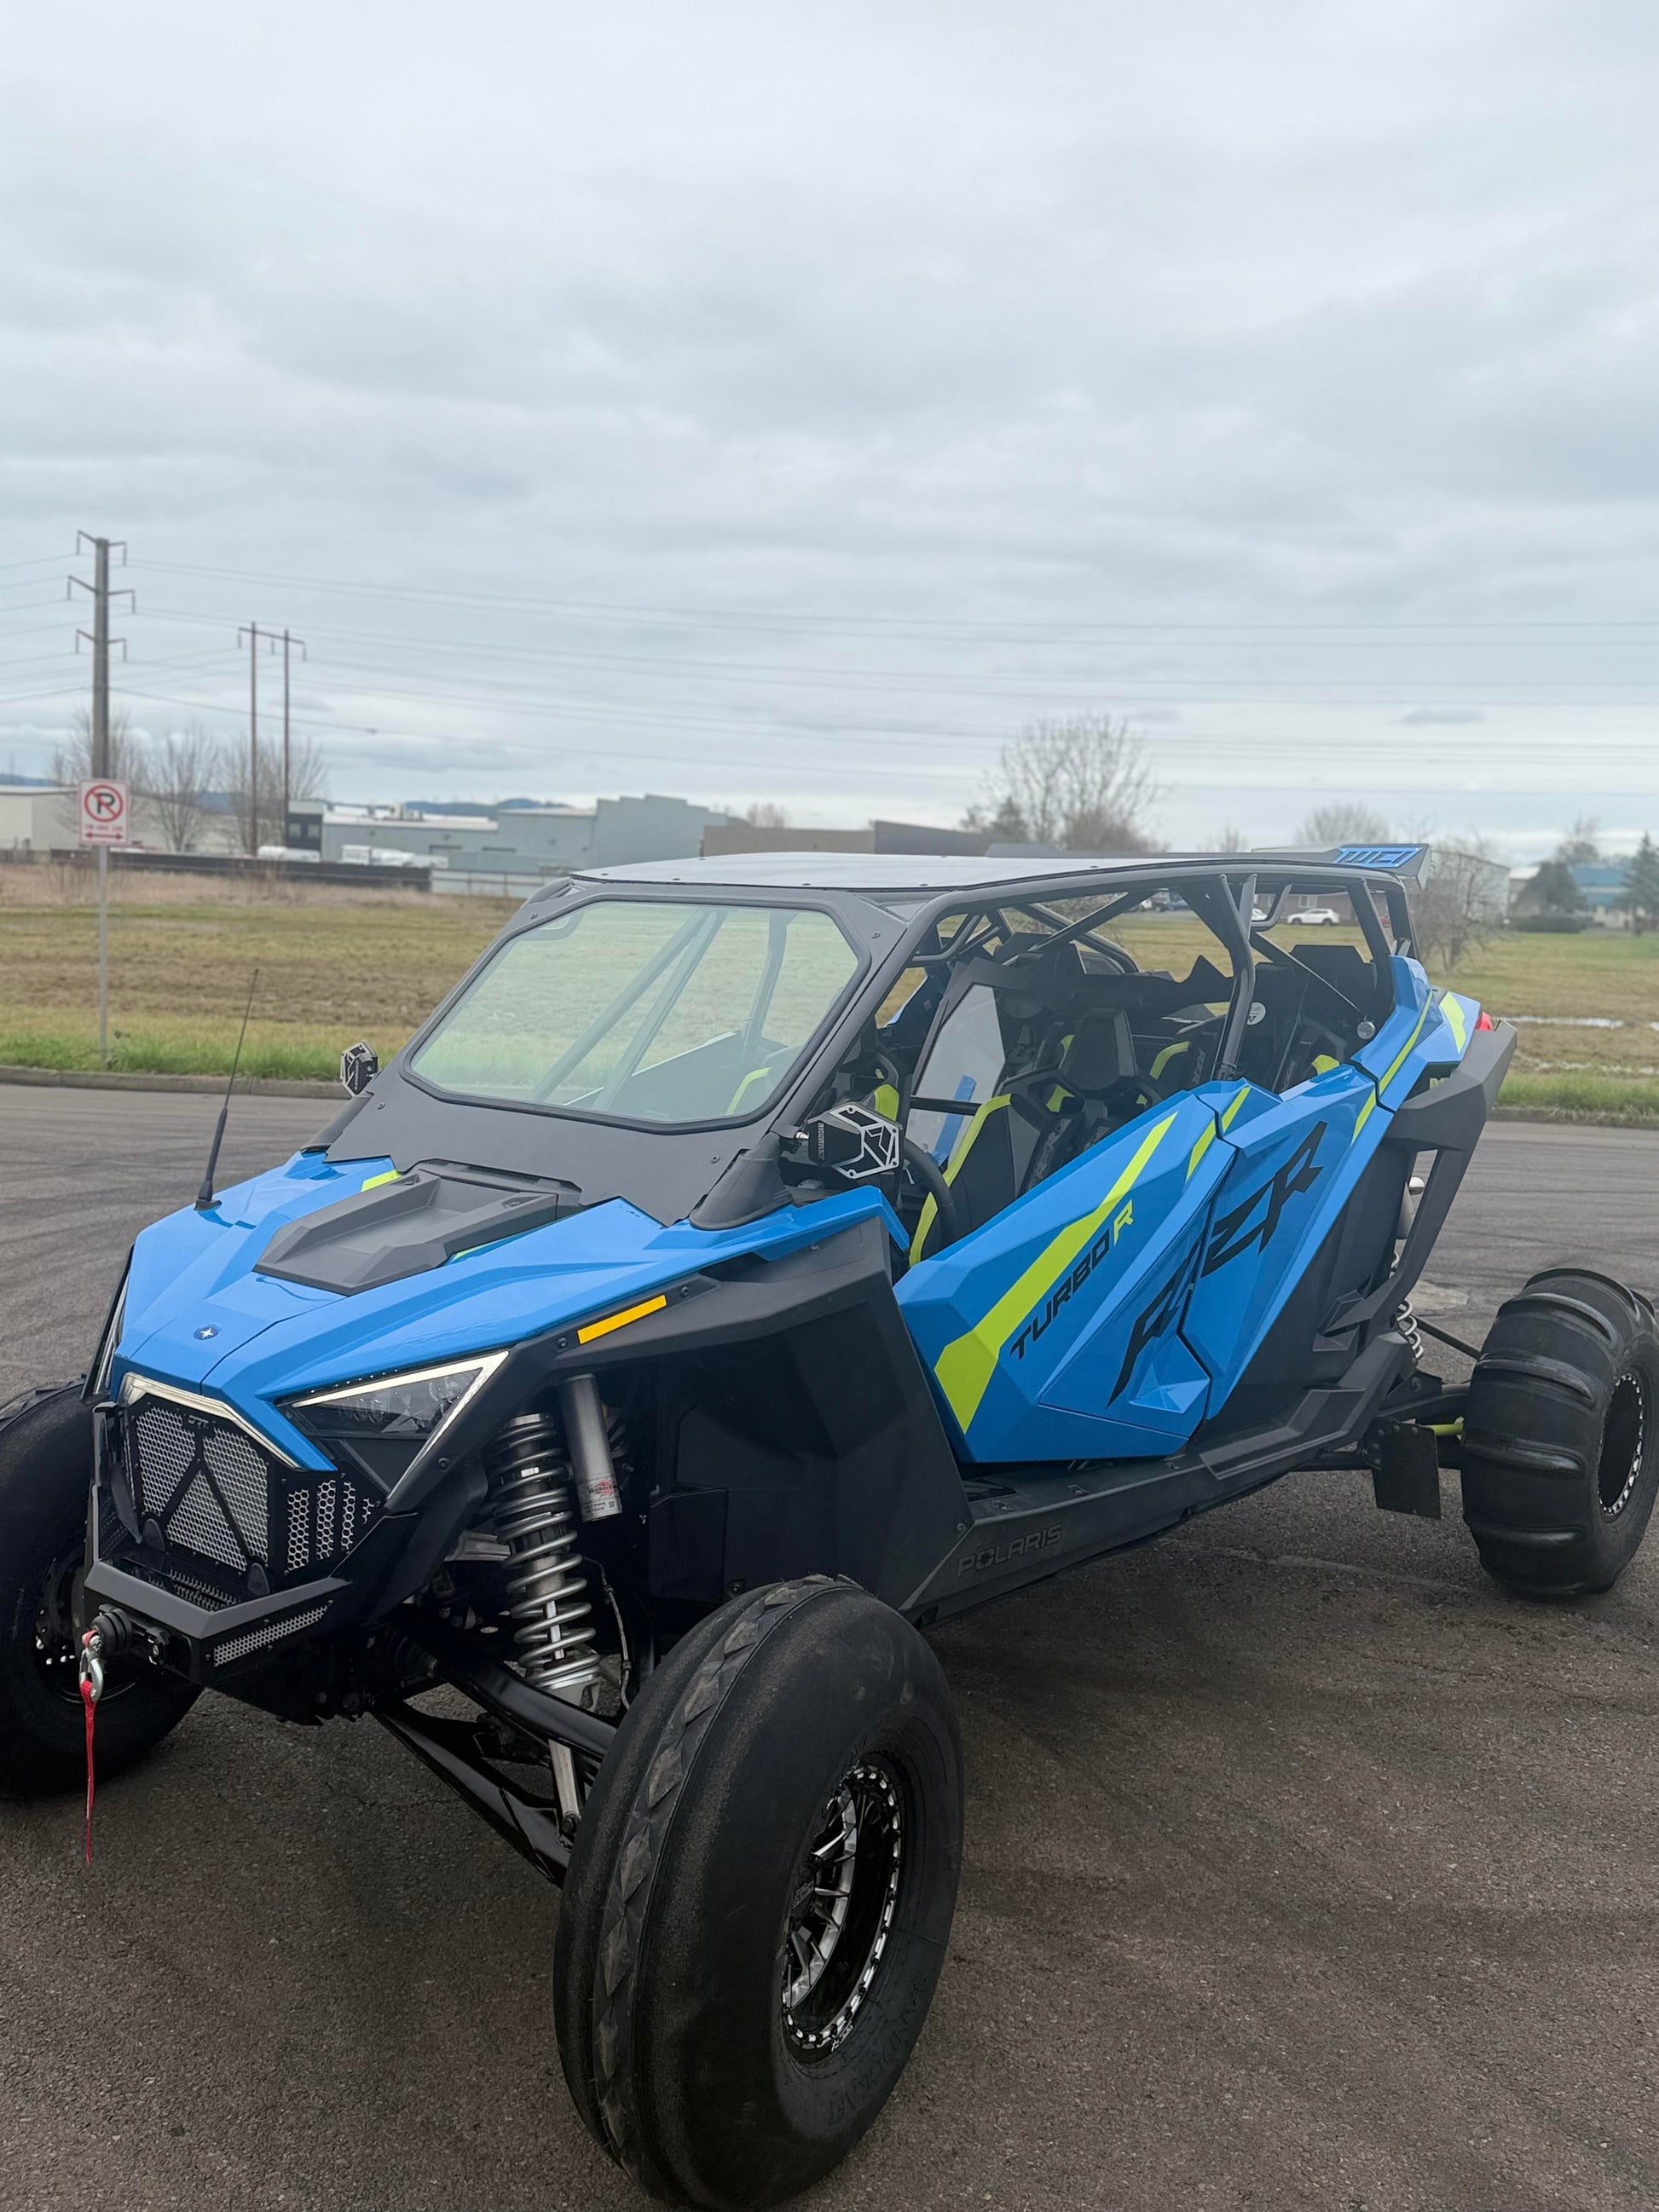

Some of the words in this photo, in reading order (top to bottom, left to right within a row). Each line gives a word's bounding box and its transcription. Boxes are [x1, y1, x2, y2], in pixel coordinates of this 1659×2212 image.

[1009, 1228, 1110, 1360] TURBO
[1113, 1199, 1134, 1247] R
[1107, 1121, 1327, 1410] RZR
[957, 1522, 1063, 1577] POLARIS
